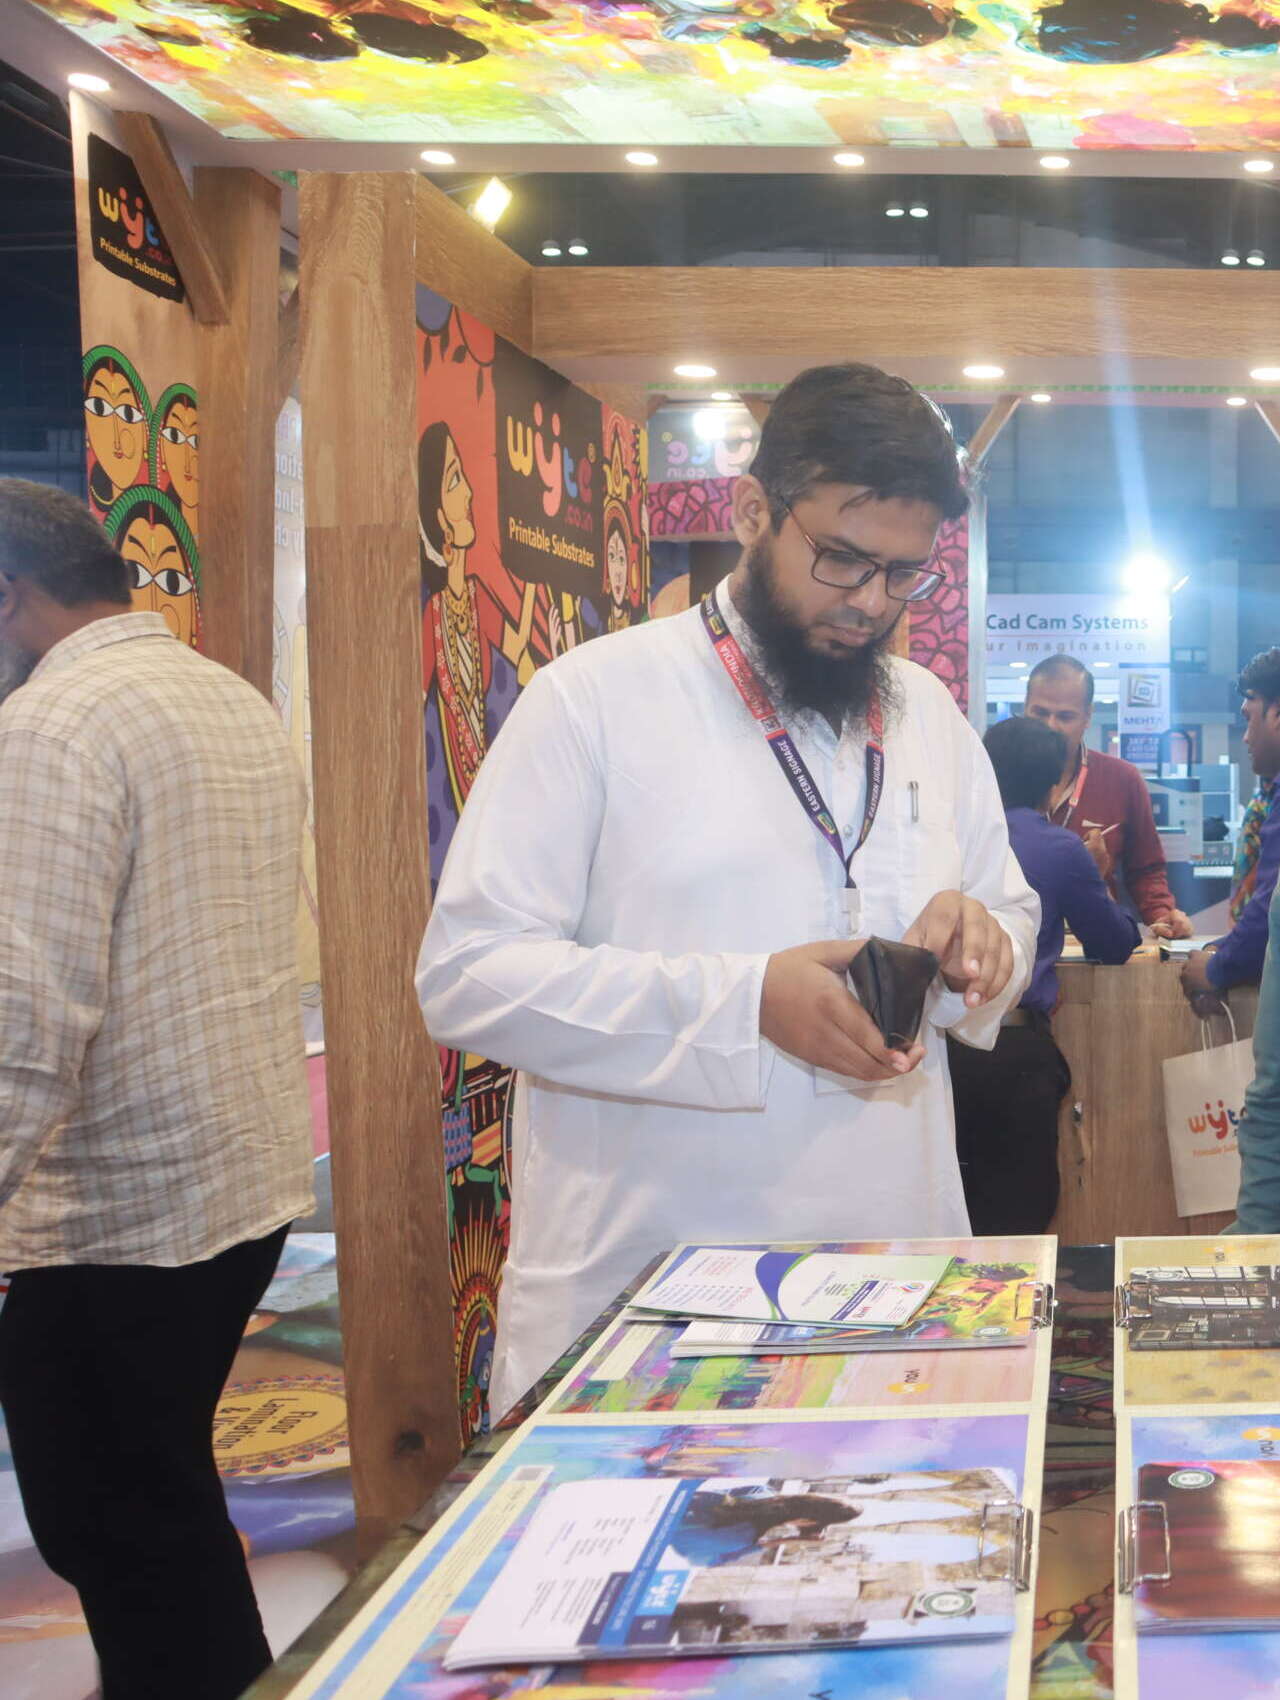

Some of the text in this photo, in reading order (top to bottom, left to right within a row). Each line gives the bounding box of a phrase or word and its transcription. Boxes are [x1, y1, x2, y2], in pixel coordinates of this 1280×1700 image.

[98, 187, 160, 249] wyt
[100, 237, 177, 287] Printable Substrates
[506, 402, 592, 517] wyte
[508, 516, 595, 568] Printable Substrates
[985, 614, 1149, 633] Cad Cam Systems
[985, 642, 1006, 651] ur
[777, 740, 820, 812] EASTERN SIGNAGE
[213, 1397, 299, 1450] Lamination
[266, 1410, 318, 1435] Floor
